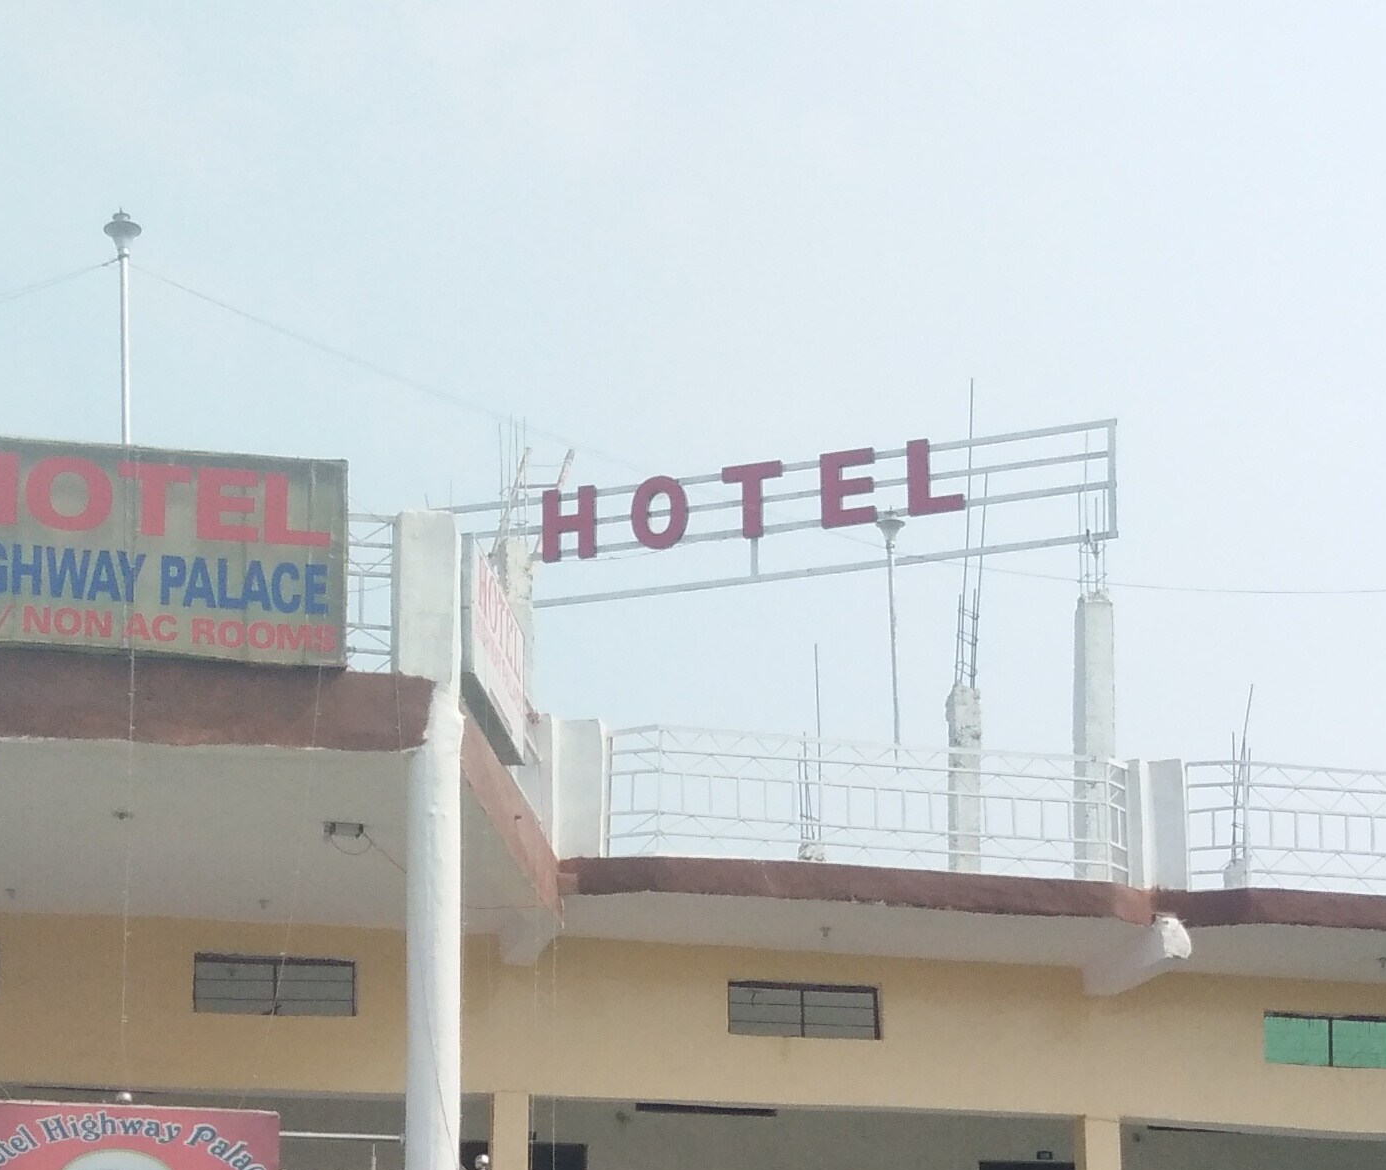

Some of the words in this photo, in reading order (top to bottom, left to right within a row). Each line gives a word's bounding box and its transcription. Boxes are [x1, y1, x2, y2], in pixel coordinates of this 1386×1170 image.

[541, 438, 965, 563] HOTEL
[160, 554, 329, 615] PALACE
[23, 604, 112, 639] NON
[124, 613, 178, 643] AC
[191, 617, 337, 652] ROOMS
[37, 1111, 182, 1144] Highway
